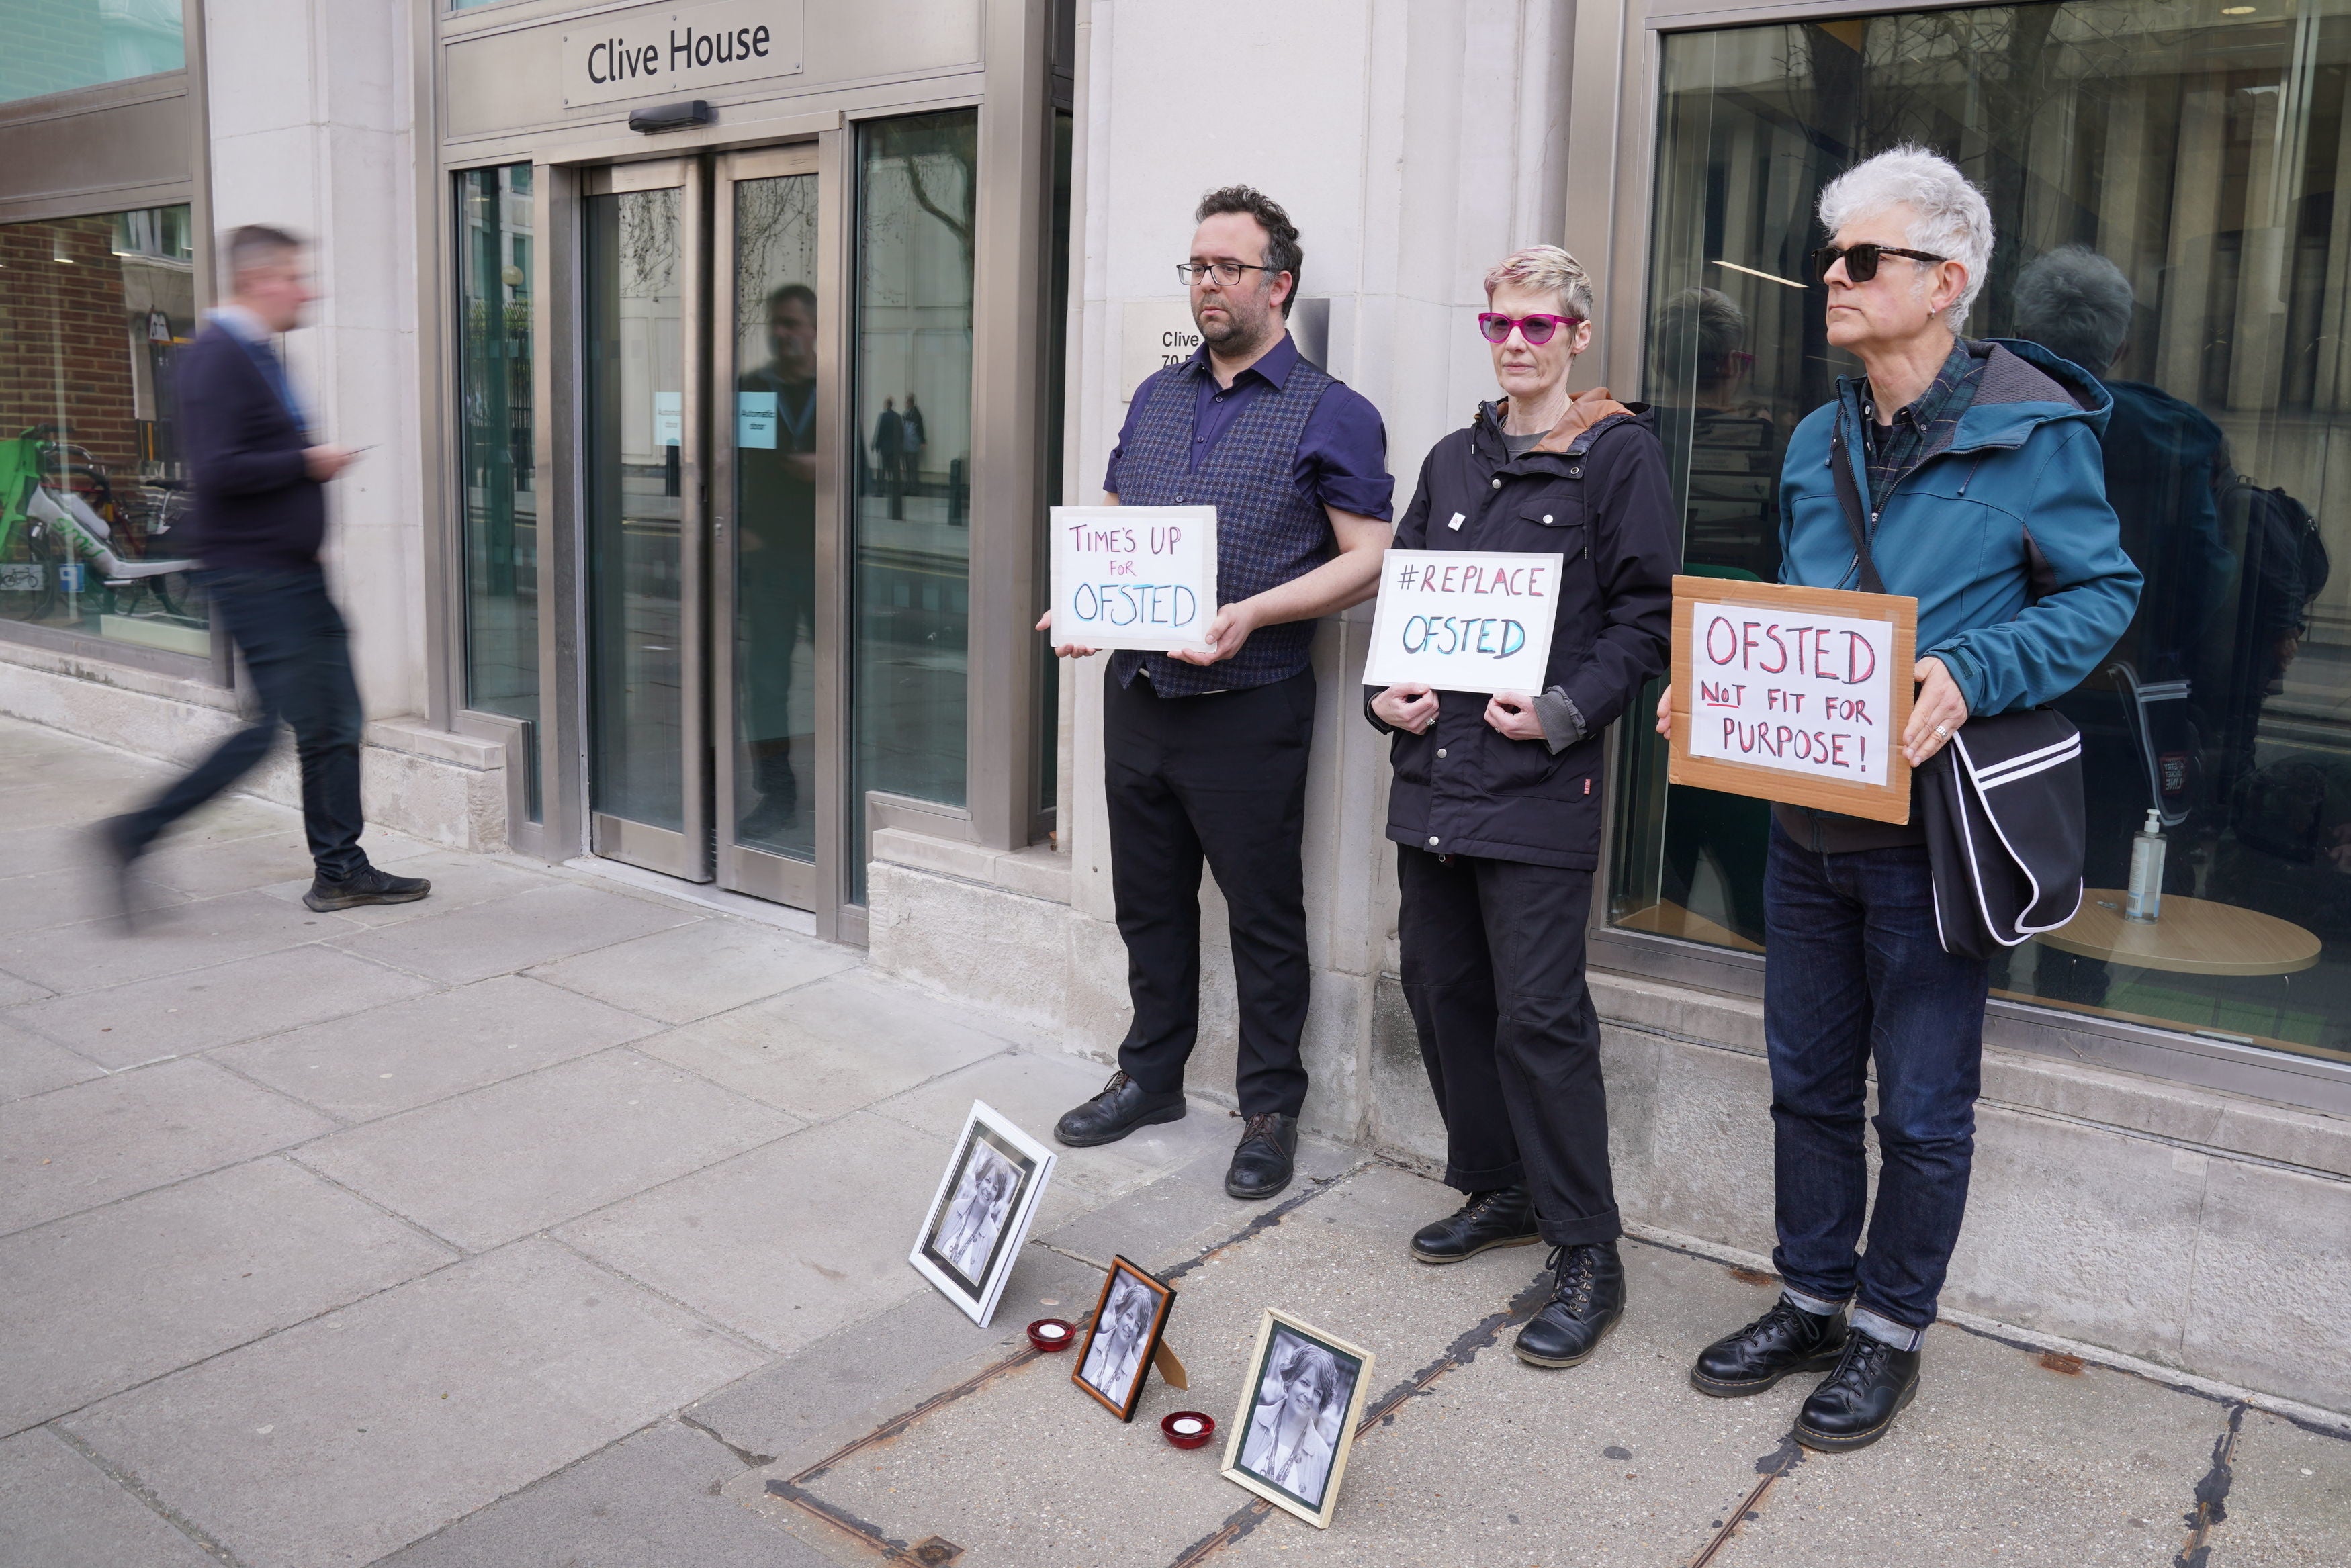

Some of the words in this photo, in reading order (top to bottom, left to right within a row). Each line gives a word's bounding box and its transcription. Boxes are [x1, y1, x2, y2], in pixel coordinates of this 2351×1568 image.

[588, 38, 658, 84] Clive
[670, 25, 770, 71] House
[1162, 331, 1199, 347] Clive
[1161, 355, 1179, 369] 70
[1069, 524, 1137, 553] TIME'S
[1151, 526, 1182, 555] UP
[1110, 560, 1137, 577] FOR
[1397, 564, 1545, 597] #REPLACE
[1074, 582, 1196, 628] OFSTED
[1403, 615, 1526, 660] OFSTED
[1707, 616, 1876, 685] OFSTED
[1701, 680, 1747, 706] NOT
[1767, 688, 1806, 714] FIT
[1825, 696, 1873, 726] FOR
[1723, 717, 1866, 772] PURPOSE!
